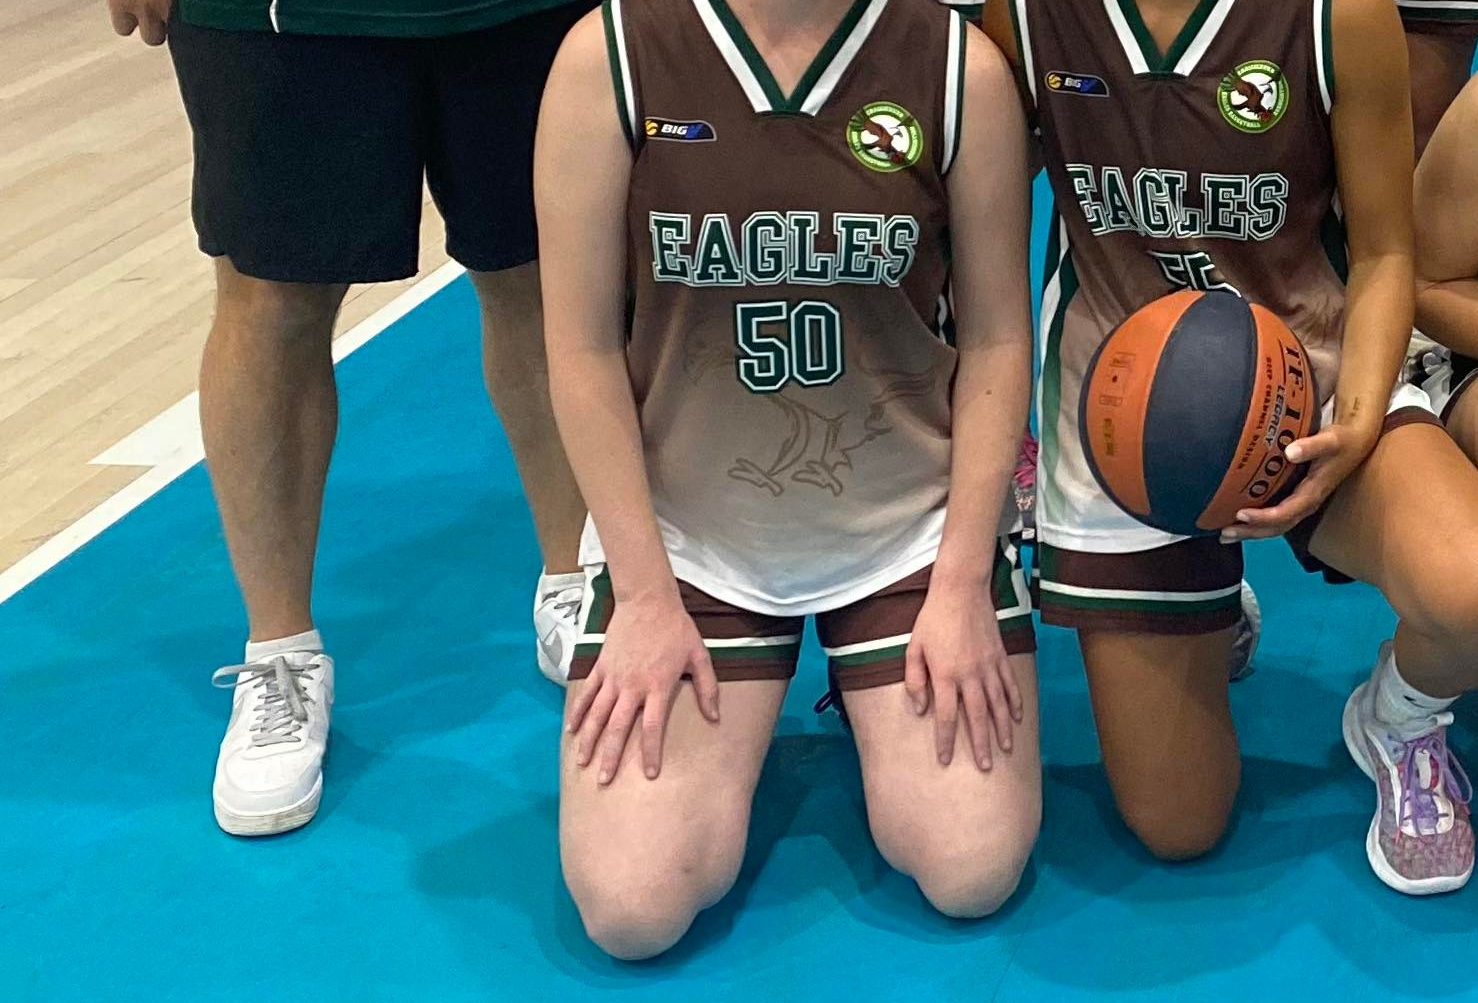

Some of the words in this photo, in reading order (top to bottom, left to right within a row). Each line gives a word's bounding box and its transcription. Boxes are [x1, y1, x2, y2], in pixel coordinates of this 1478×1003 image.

[1066, 163, 1289, 241] EAGLES
[649, 211, 919, 287] EAGLES
[737, 301, 841, 391] 50
[1248, 345, 1305, 498] TF-1000
